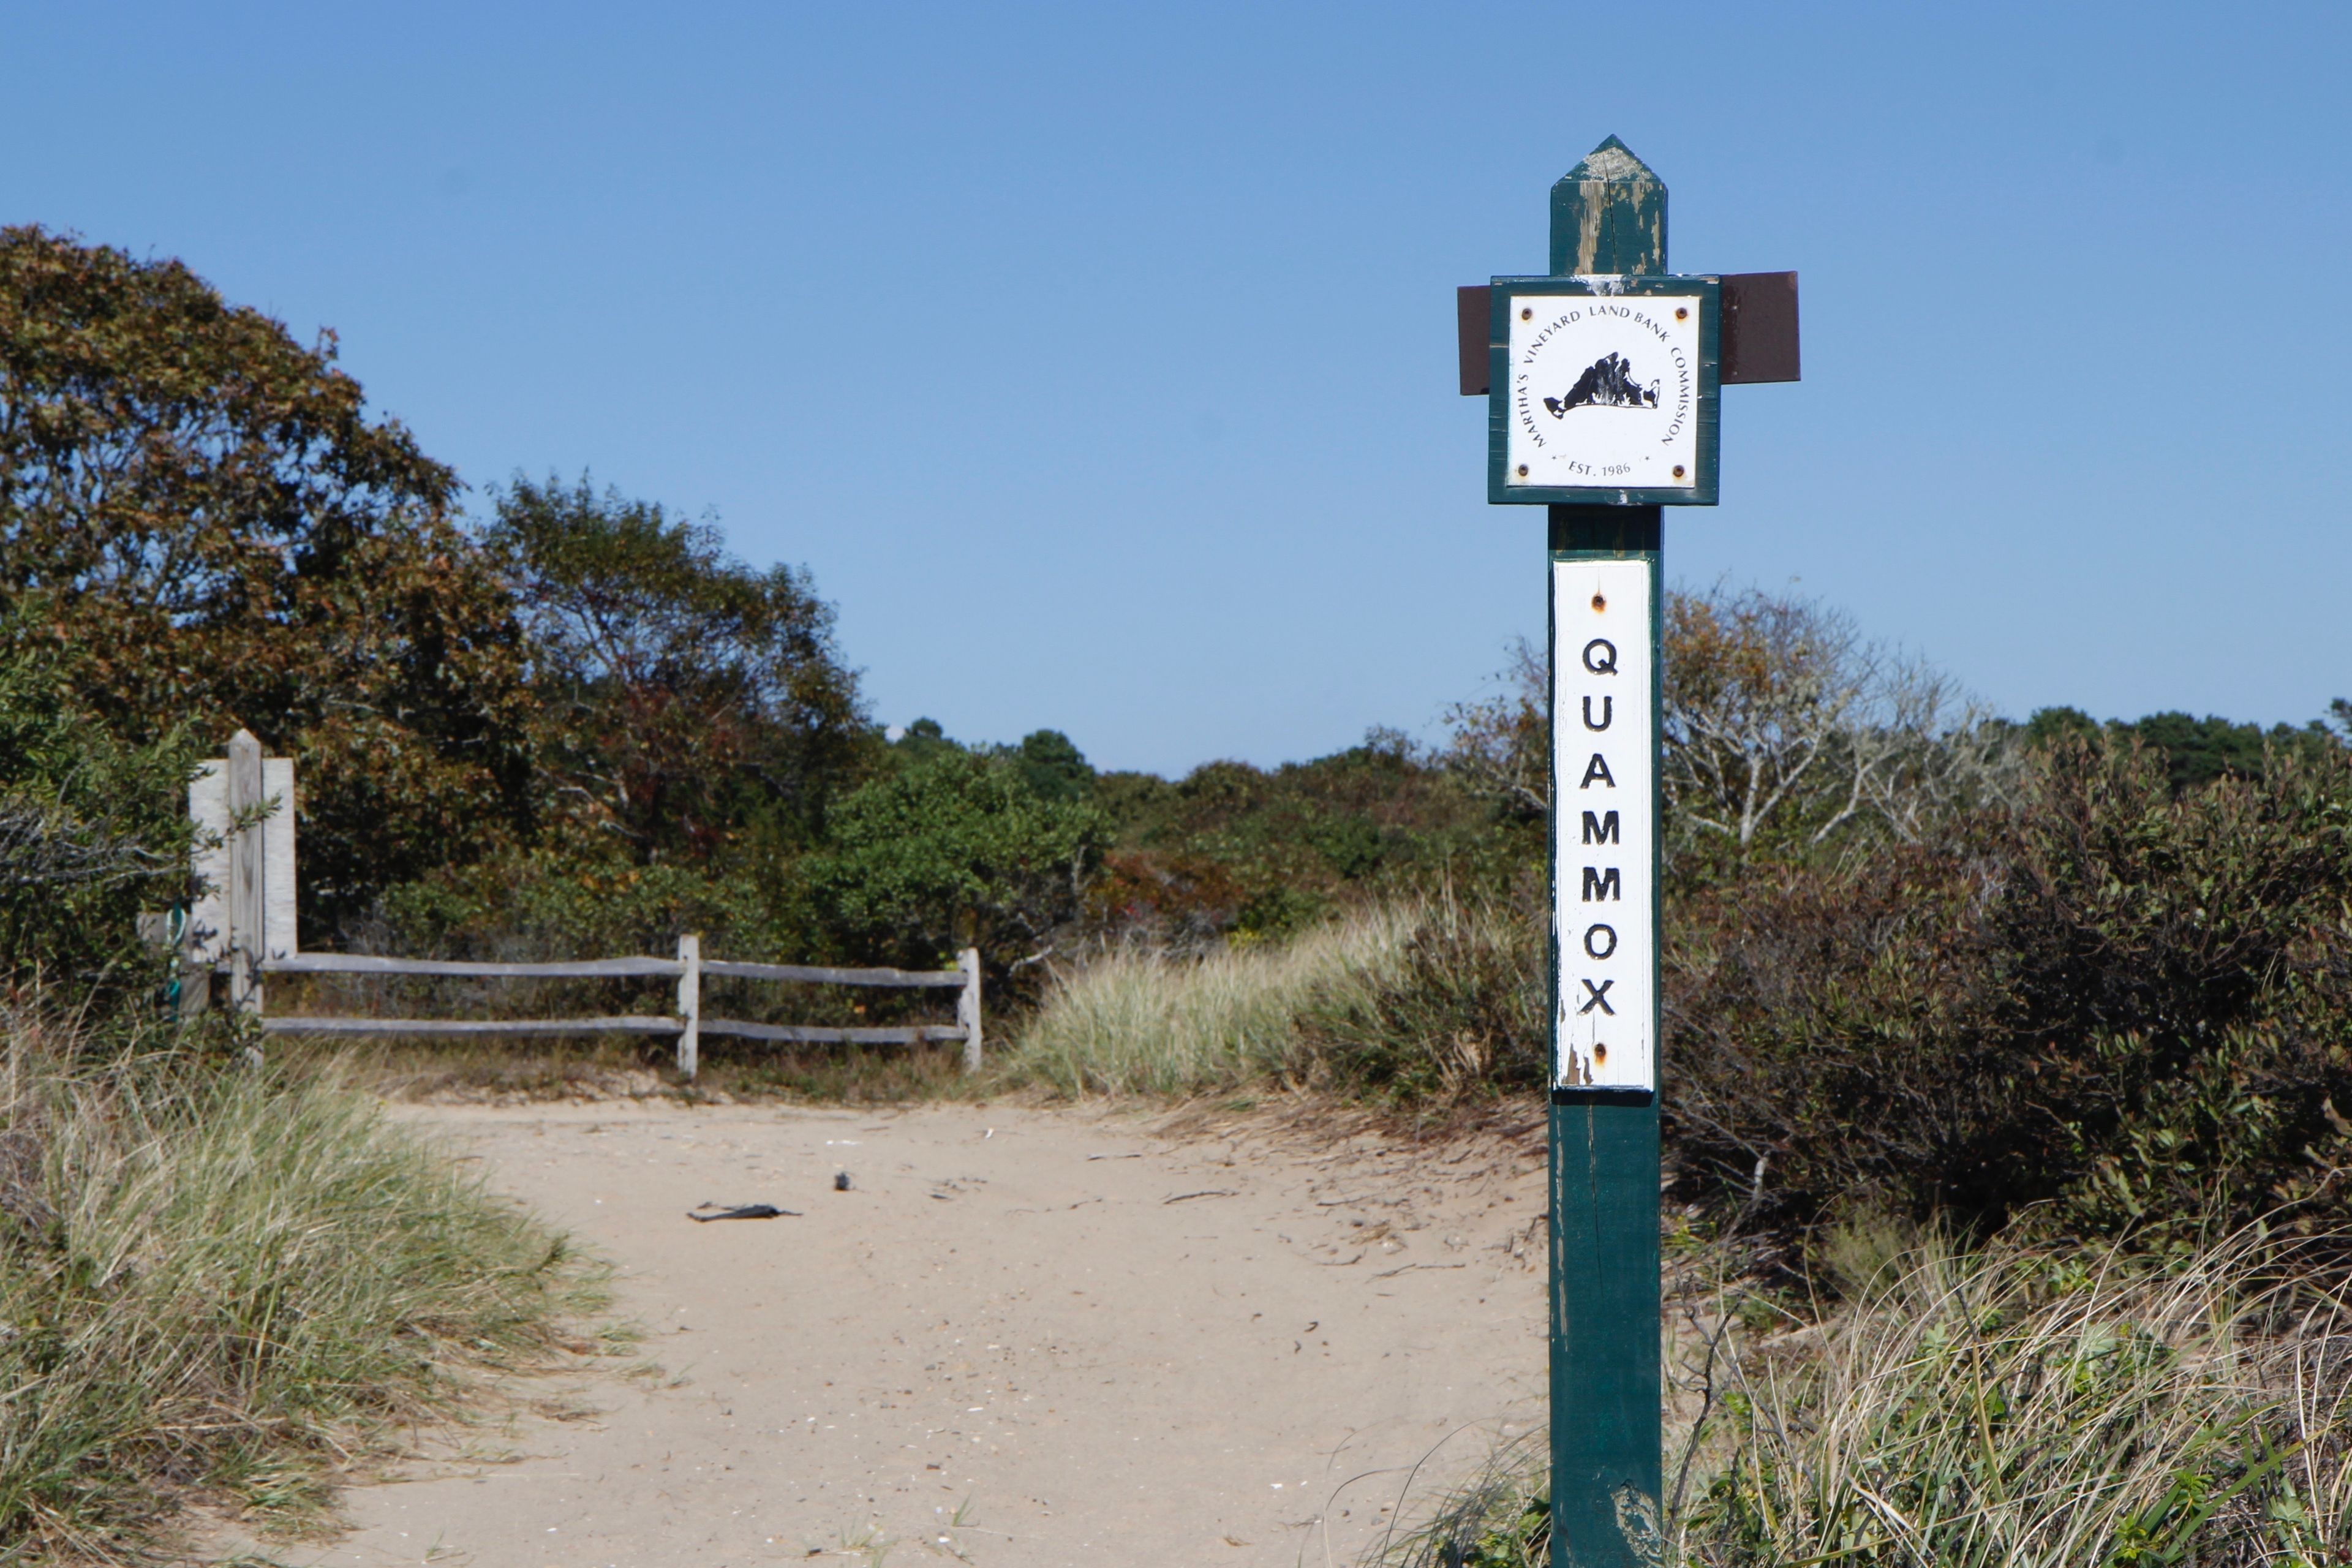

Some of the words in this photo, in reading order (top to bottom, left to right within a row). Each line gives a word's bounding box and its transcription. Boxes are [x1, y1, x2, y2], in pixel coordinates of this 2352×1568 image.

[1523, 311, 1580, 363] VINEYARD
[1589, 305, 1630, 318] LAND
[1634, 312, 1670, 342] BANK
[1518, 374, 1547, 448] MARTHA'S
[1662, 347, 1689, 446] COMMISSION
[1569, 461, 1596, 477] EST.
[1602, 463, 1630, 476] 1986
[1579, 638, 1621, 1017] QUAMMOX
